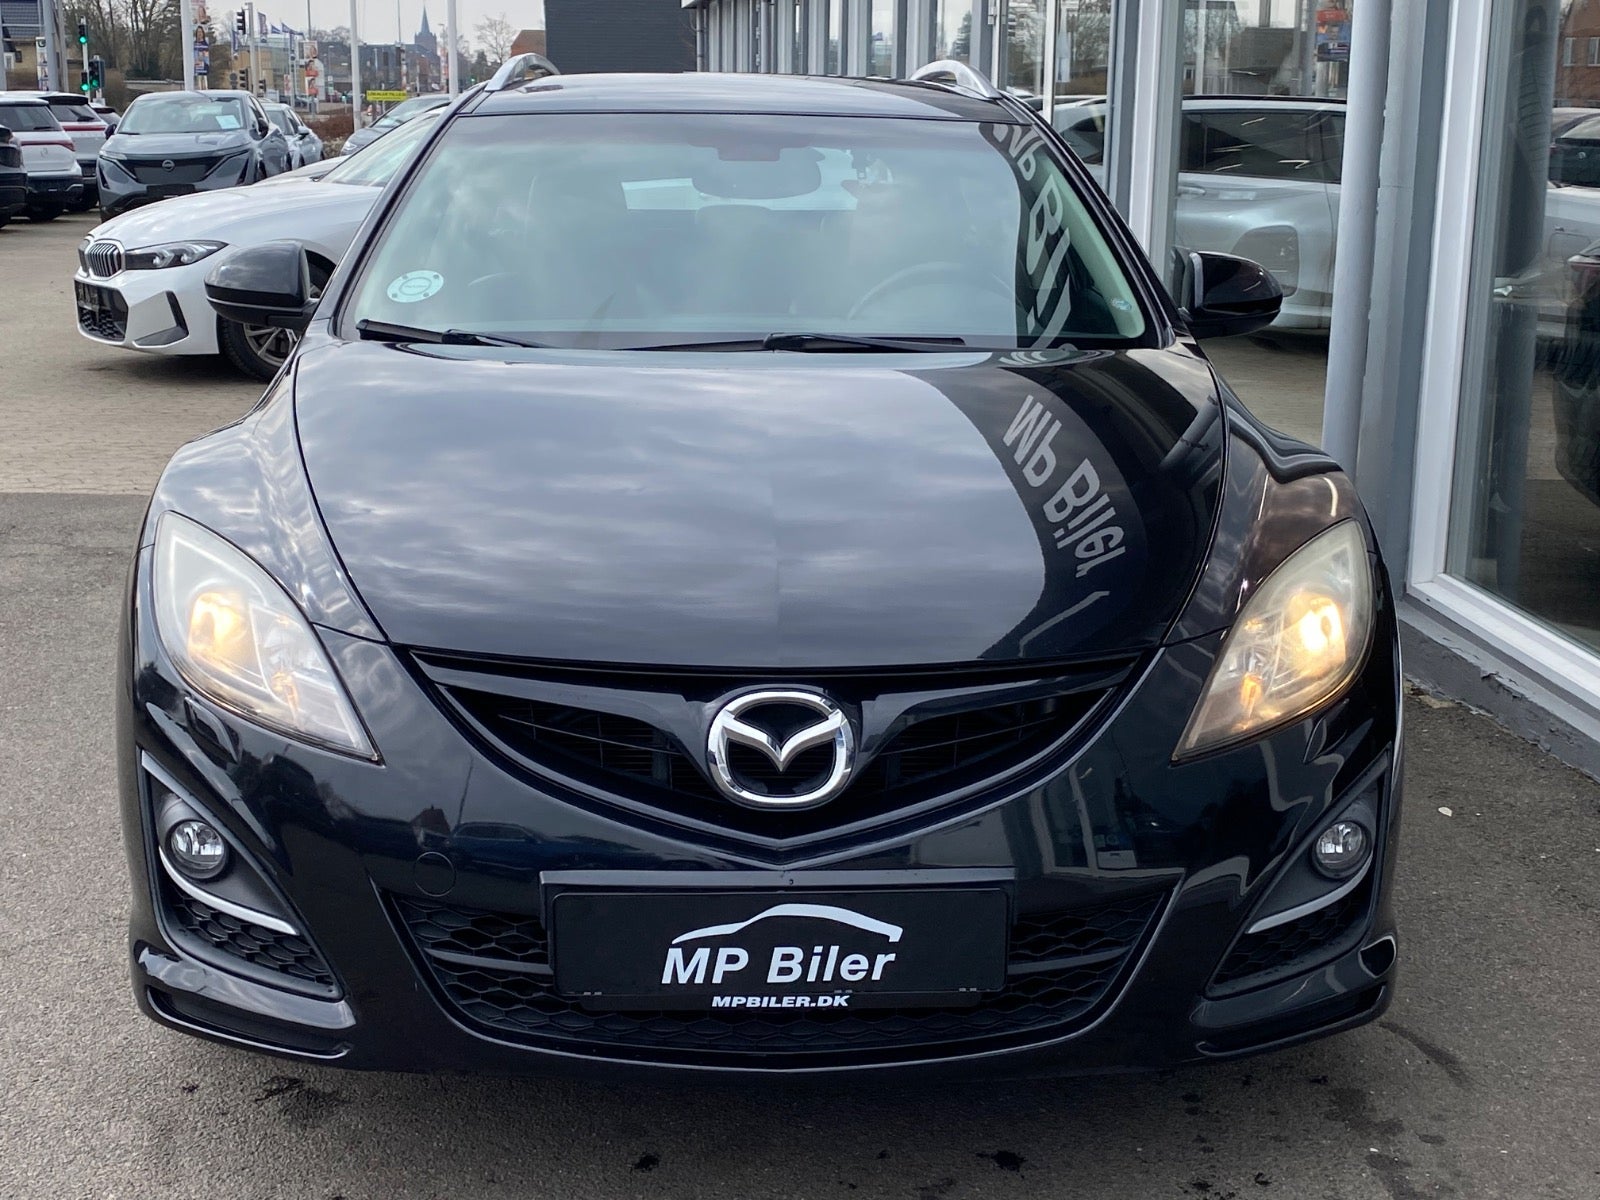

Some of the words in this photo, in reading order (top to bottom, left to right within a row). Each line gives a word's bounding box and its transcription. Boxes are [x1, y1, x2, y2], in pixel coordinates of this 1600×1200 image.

[661, 947, 749, 984] MP
[766, 945, 896, 983] Biler
[712, 995, 850, 1008] MPBILER.DK
